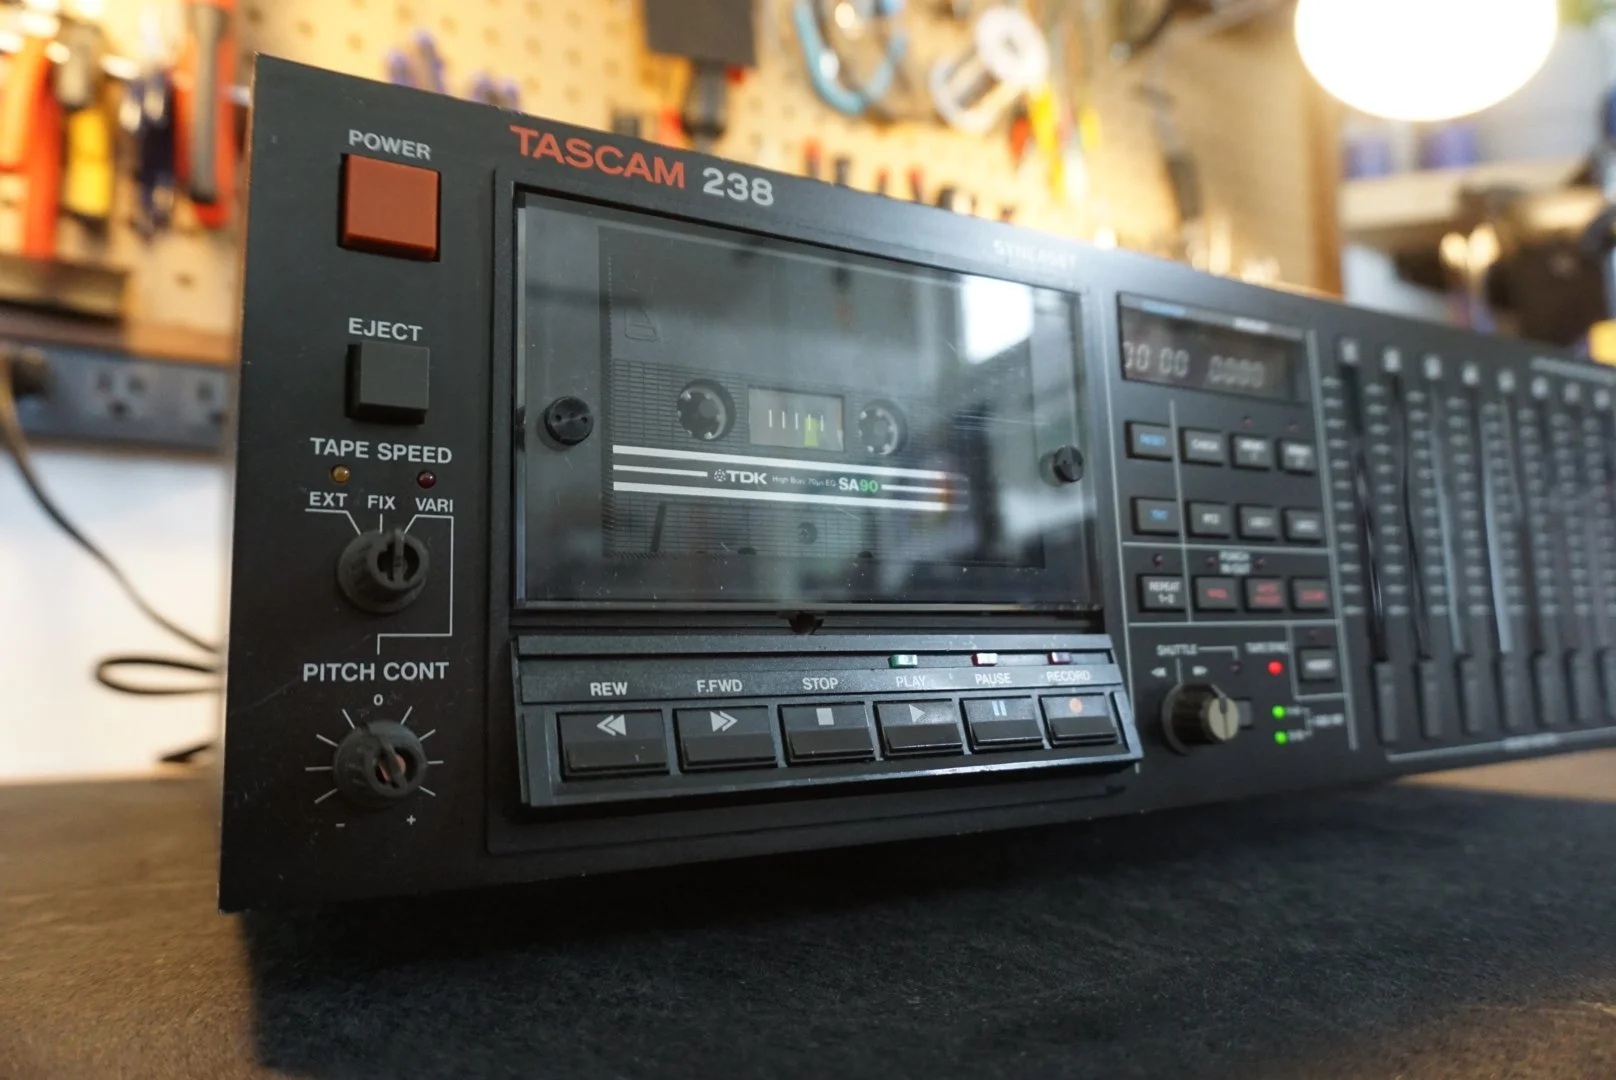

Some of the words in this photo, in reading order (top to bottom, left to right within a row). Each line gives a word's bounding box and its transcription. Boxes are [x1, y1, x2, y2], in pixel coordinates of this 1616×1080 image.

[348, 129, 432, 161] POWER
[509, 125, 686, 189] TASCAM
[702, 167, 774, 207] 238
[348, 316, 423, 342] EJECT
[310, 437, 370, 459] TAPE
[377, 442, 452, 464] SPEED
[725, 469, 767, 485] TDK
[838, 477, 879, 493] SA90
[309, 491, 348, 508] EXT
[367, 494, 396, 510] FIX
[415, 497, 454, 512] VARI
[1156, 643, 1197, 656] SHUTTLE
[303, 662, 375, 682] PITCH
[383, 661, 450, 681] CONT
[975, 672, 1012, 686] PAUSE
[1046, 670, 1091, 683] RECORD
[696, 679, 743, 694] F.FWD
[802, 677, 839, 691] STOP
[896, 675, 927, 688] PLAY
[590, 682, 628, 697] REW
